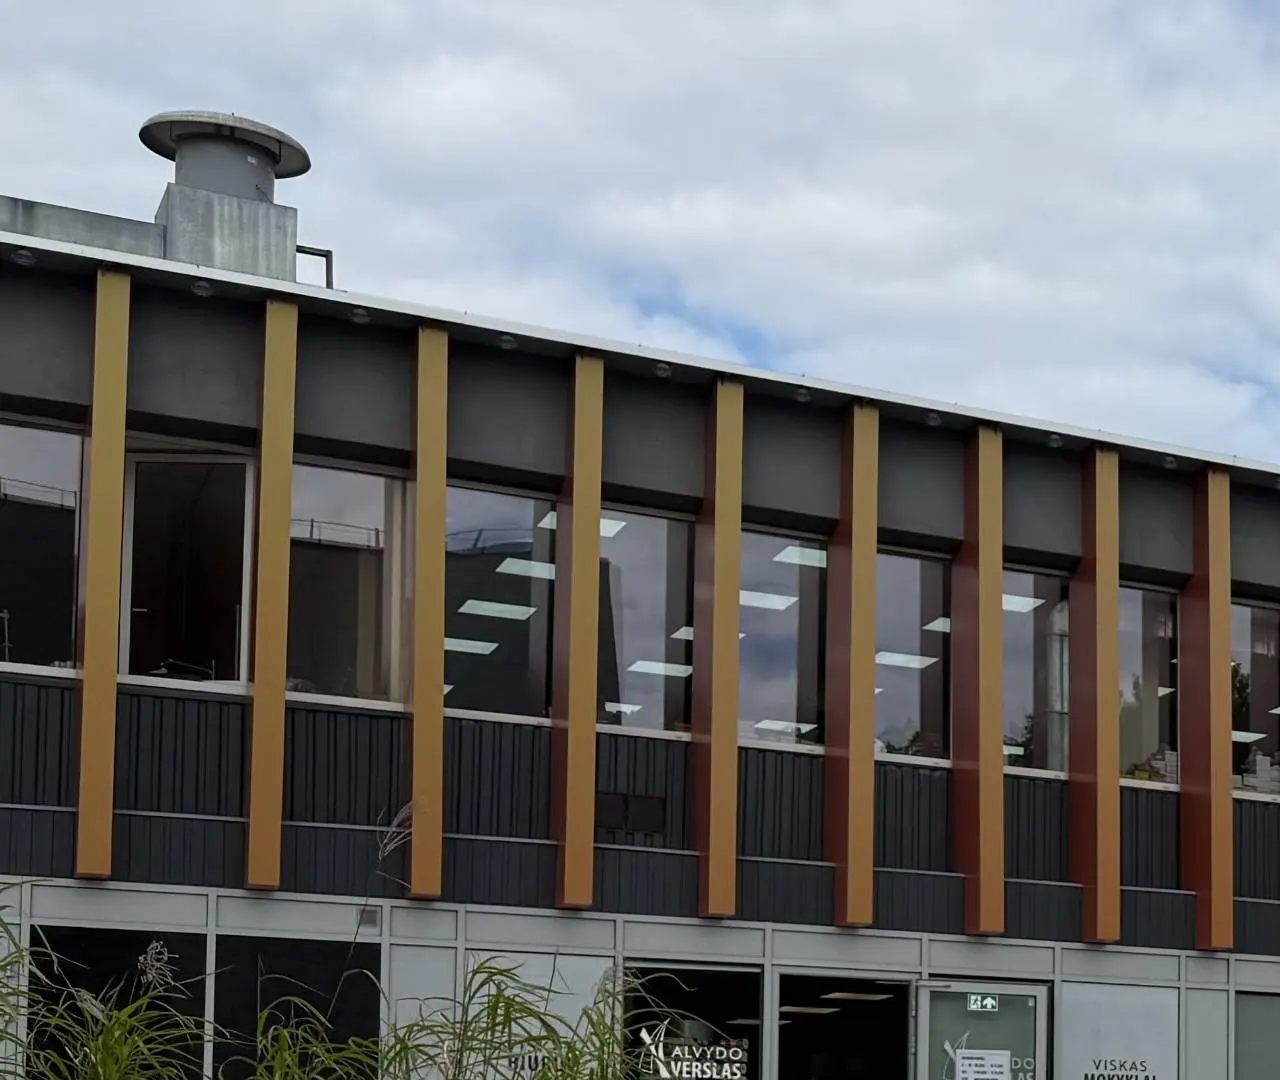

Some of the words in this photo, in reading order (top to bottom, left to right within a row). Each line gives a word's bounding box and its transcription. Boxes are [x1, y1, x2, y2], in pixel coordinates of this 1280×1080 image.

[671, 1047, 743, 1061] ALVYDO
[671, 1062, 742, 1080] VERSLAS
[1093, 1059, 1147, 1072] VISKAS
